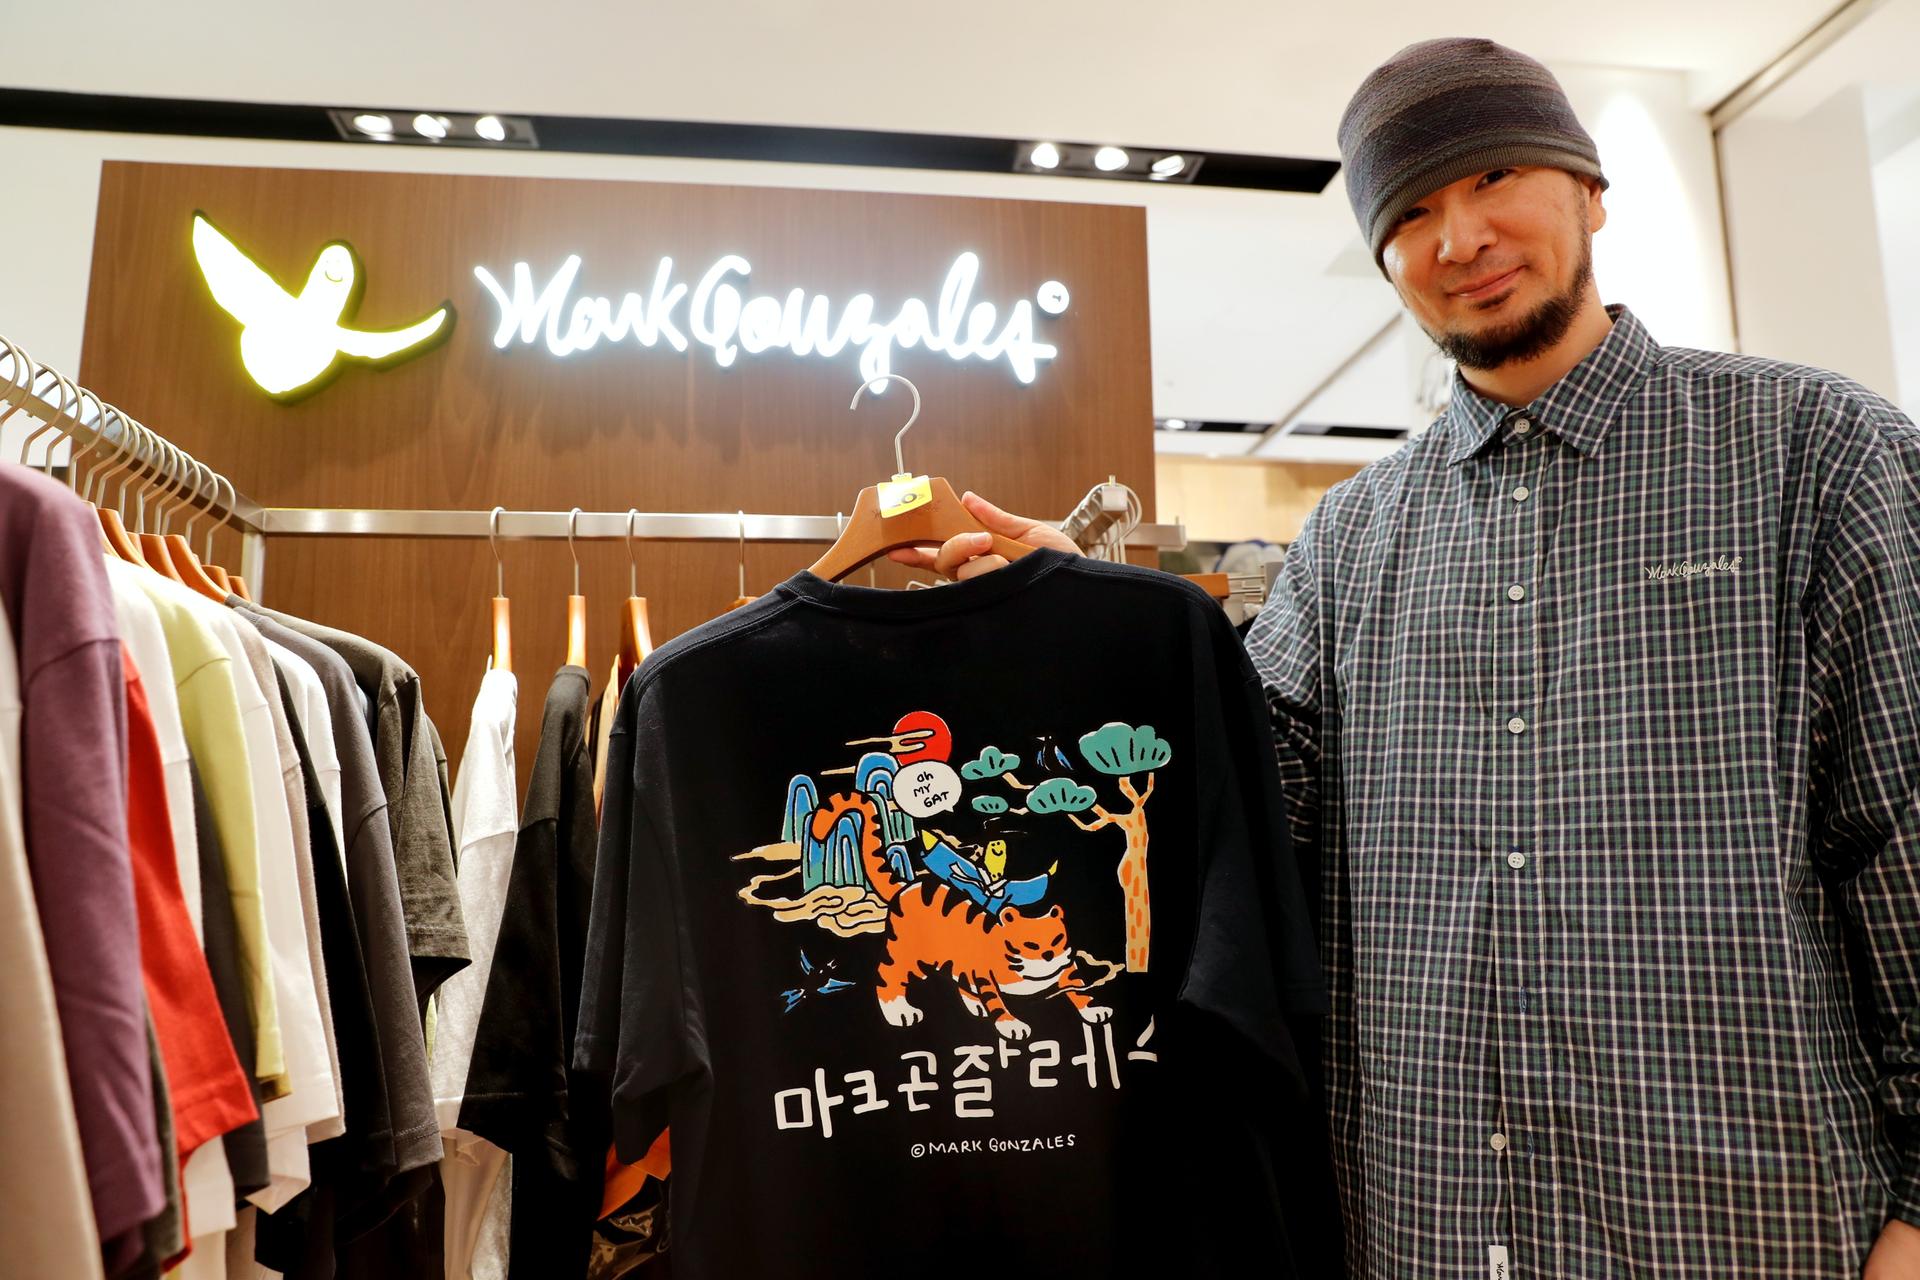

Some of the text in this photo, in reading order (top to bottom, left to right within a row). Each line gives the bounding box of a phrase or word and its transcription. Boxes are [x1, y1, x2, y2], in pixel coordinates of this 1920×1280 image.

[474, 253, 688, 357] Mark
[913, 783, 931, 797] MY
[988, 1133, 1076, 1153] GONZALES
